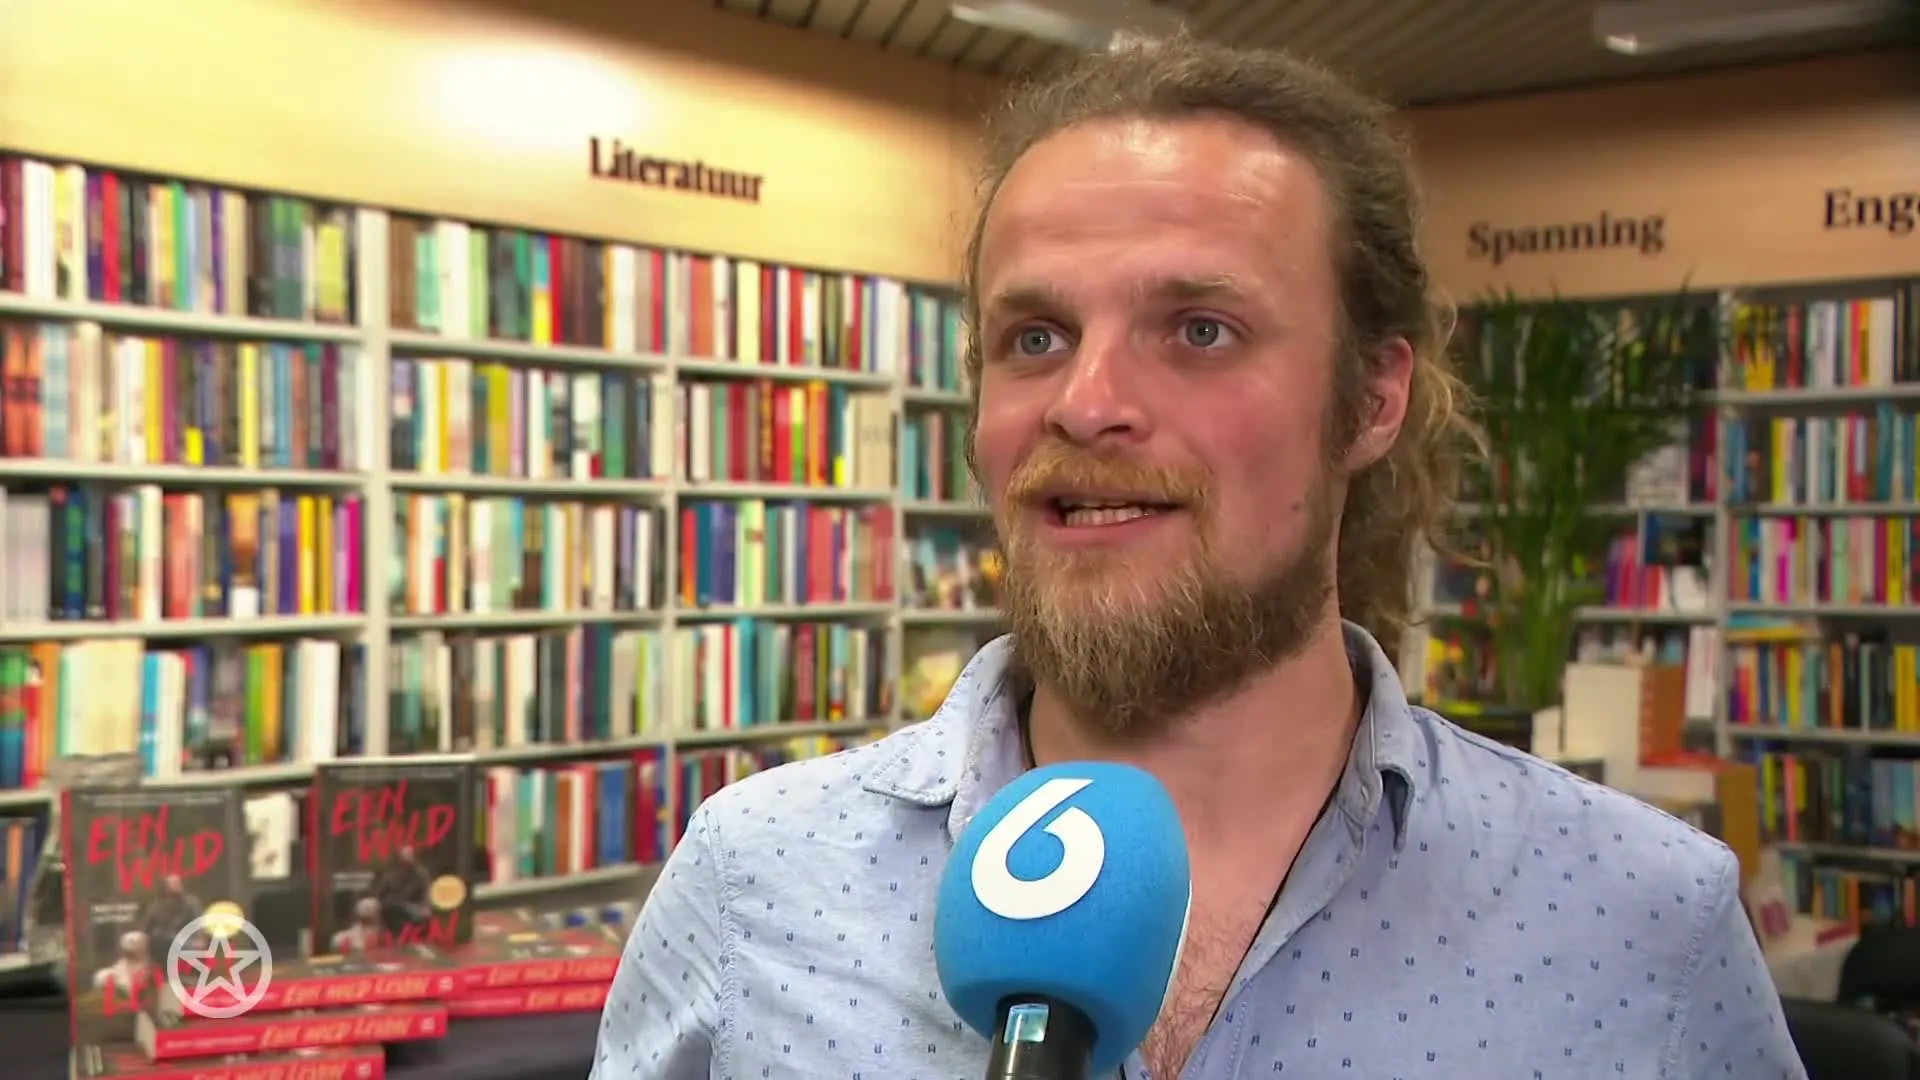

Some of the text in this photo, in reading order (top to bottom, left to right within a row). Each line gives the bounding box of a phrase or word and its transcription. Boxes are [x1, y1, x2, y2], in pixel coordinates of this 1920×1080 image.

[590, 136, 764, 204] Literatuur
[1467, 210, 1665, 265] Spanning
[1823, 187, 1920, 238] Eng
[87, 803, 170, 865] EEN
[331, 778, 408, 837] EEN
[358, 806, 455, 863] WILD
[116, 831, 224, 893] WILD
[971, 778, 1105, 920] 6
